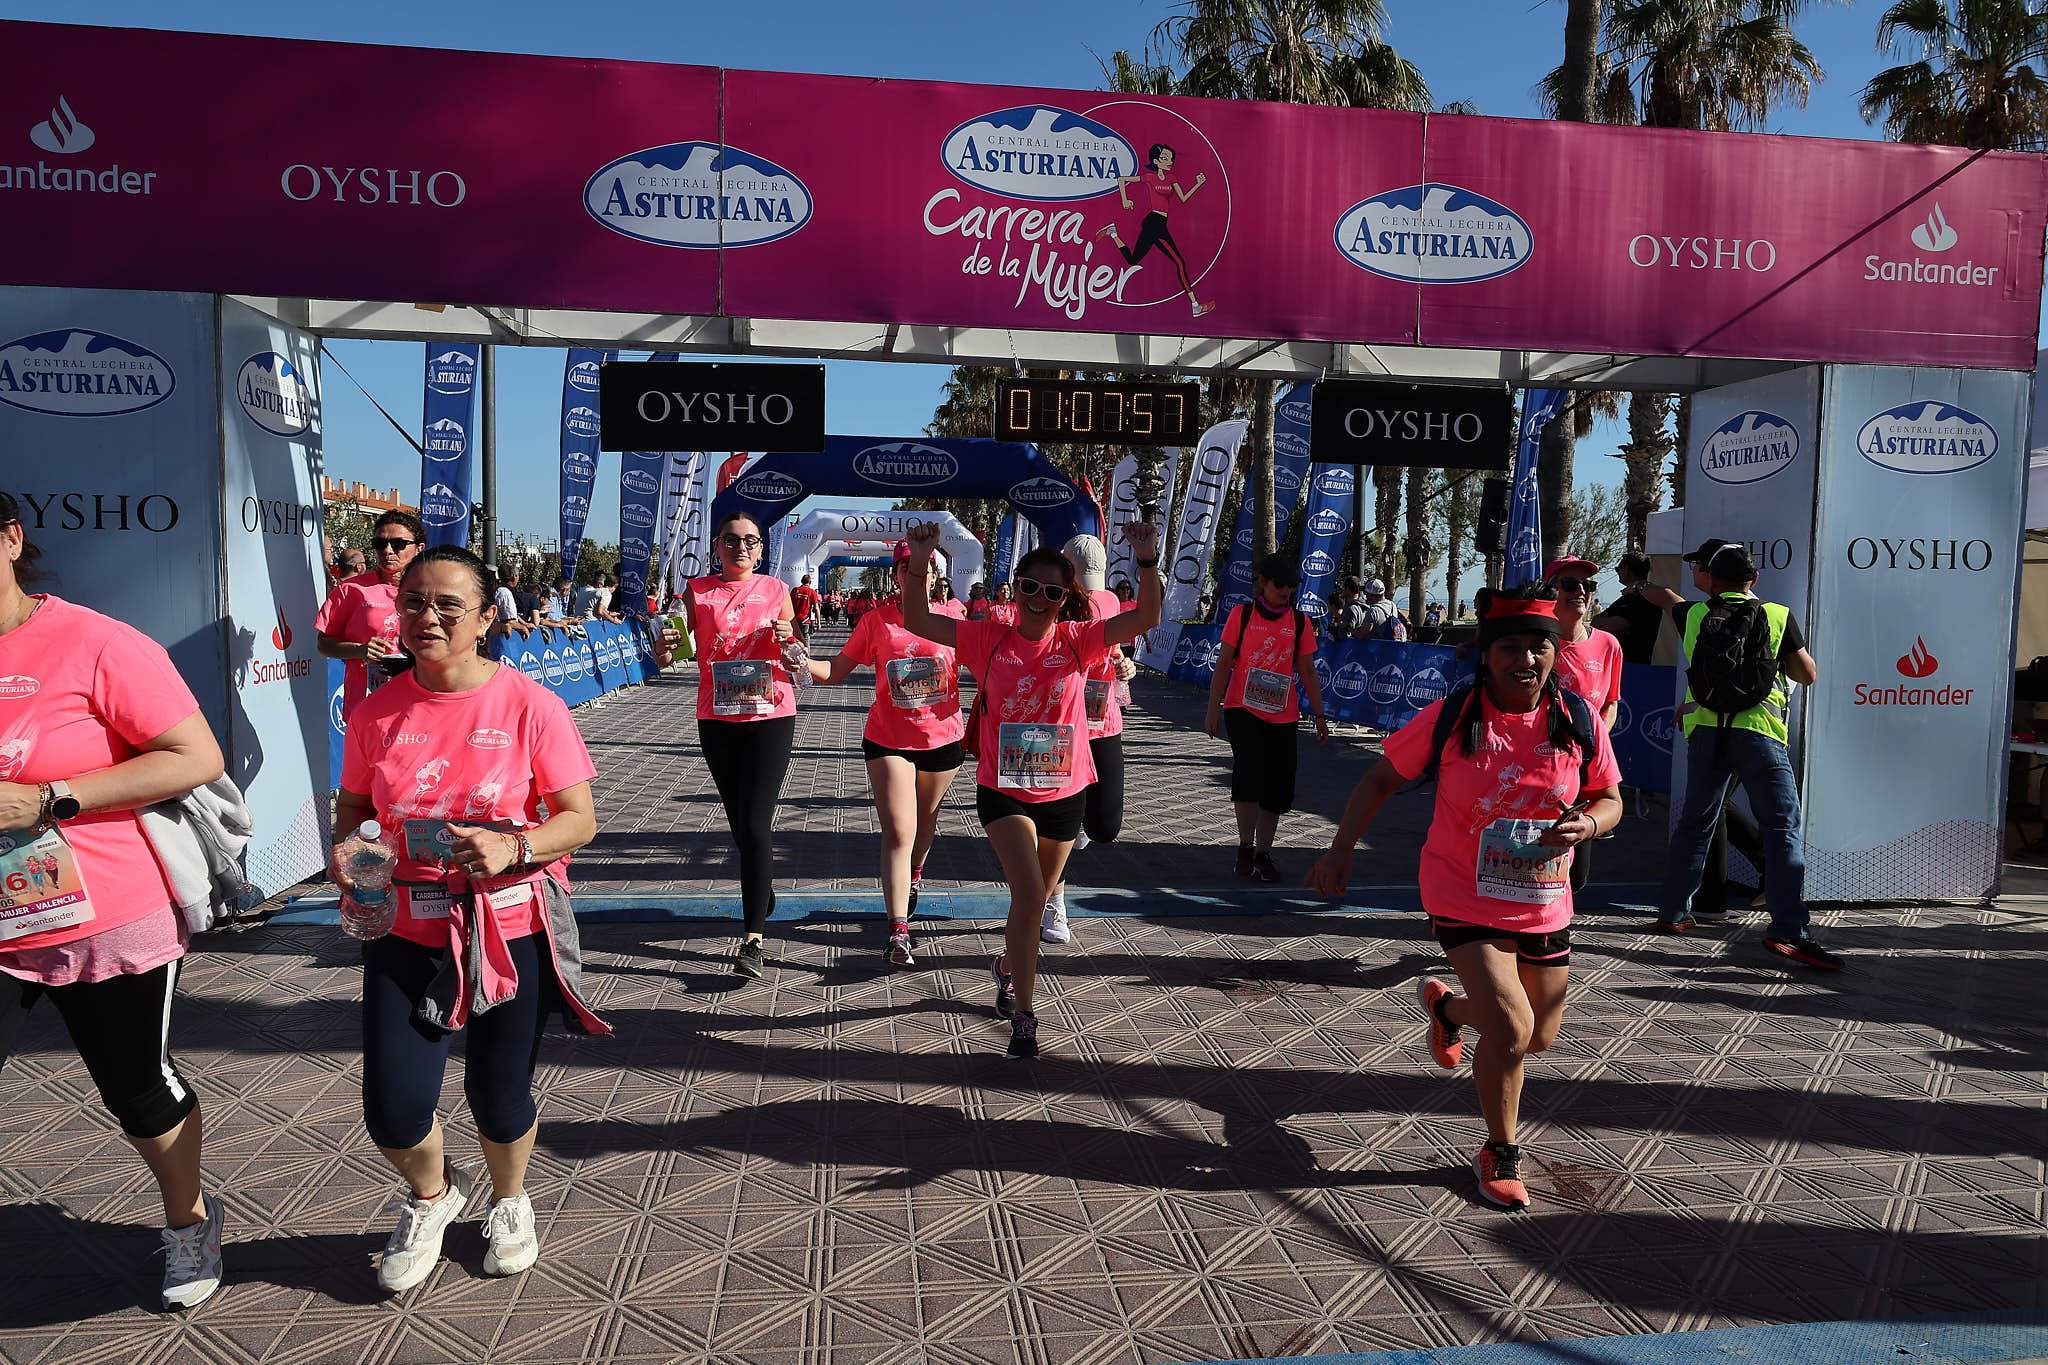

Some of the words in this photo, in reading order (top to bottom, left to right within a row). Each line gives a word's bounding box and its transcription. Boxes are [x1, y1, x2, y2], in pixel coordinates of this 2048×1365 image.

[987, 135, 1049, 148] CENTRAL
[1056, 140, 1118, 152] LECHERA
[957, 135, 1121, 180] ASTURIANA
[0, 163, 157, 196] antander
[281, 164, 466, 208] OYSHO
[637, 176, 709, 189] CENTRAL
[602, 177, 796, 223] ASTURIANA
[923, 188, 1084, 245] Carrera
[1381, 215, 1443, 228] CENTRAL
[1450, 219, 1512, 231] LECHERA
[1350, 216, 1518, 260] ASTURIANA
[1628, 233, 1777, 273] OYSHO
[961, 242, 992, 276] de
[998, 242, 1020, 278] la
[1013, 242, 1143, 320] Mujer
[1863, 253, 1999, 287] Santander
[23, 358, 86, 369] CENTRAL
[92, 359, 155, 370] LECHERA
[0, 359, 162, 396] ASTURIANA
[428, 366, 472, 385] ASTURIAN
[571, 370, 600, 386] ASTURIA
[244, 372, 309, 422] ASTURIANA
[637, 389, 795, 427] OYSHO
[1010, 389, 1184, 433] 01:07:57
[1343, 407, 1484, 444] OYSHO
[1889, 424, 1934, 434] CENTRAL
[1937, 425, 1984, 436] LECHERA
[1275, 440, 1308, 455] STURIANA
[1720, 437, 1751, 448] CENTRAL
[1753, 430, 1789, 444] LECHERA
[1866, 426, 1988, 457] ASTURIANA
[861, 454, 952, 478] ASTURIANA
[1706, 440, 1791, 470] ASTURIANA
[740, 481, 798, 496] ASTURIANA
[1014, 487, 1071, 500] ASTURIANA
[0, 492, 179, 533] YSHO
[242, 496, 315, 538] OYSHO
[1174, 446, 1230, 585] OYSHO
[842, 516, 922, 533] OYSHO
[793, 532, 819, 541] OYSHO
[1846, 537, 1993, 571] OYSHO
[253, 656, 312, 685] Santander
[0, 685, 36, 693] TURIANA
[1853, 684, 1974, 706] Santander
[382, 733, 428, 748] OSHO
[470, 735, 509, 745] ASTURIANA
[1481, 875, 1506, 885] CARRERA
[1485, 885, 1516, 897] OYSHO
[0, 898, 15, 908] 09
[0, 906, 29, 918] MUJER
[36, 894, 78, 911] VALENCIA
[416, 891, 445, 899] CARRERA
[490, 892, 519, 903] ntander
[27, 911, 75, 928] Santander
[422, 904, 450, 913] OYSH
